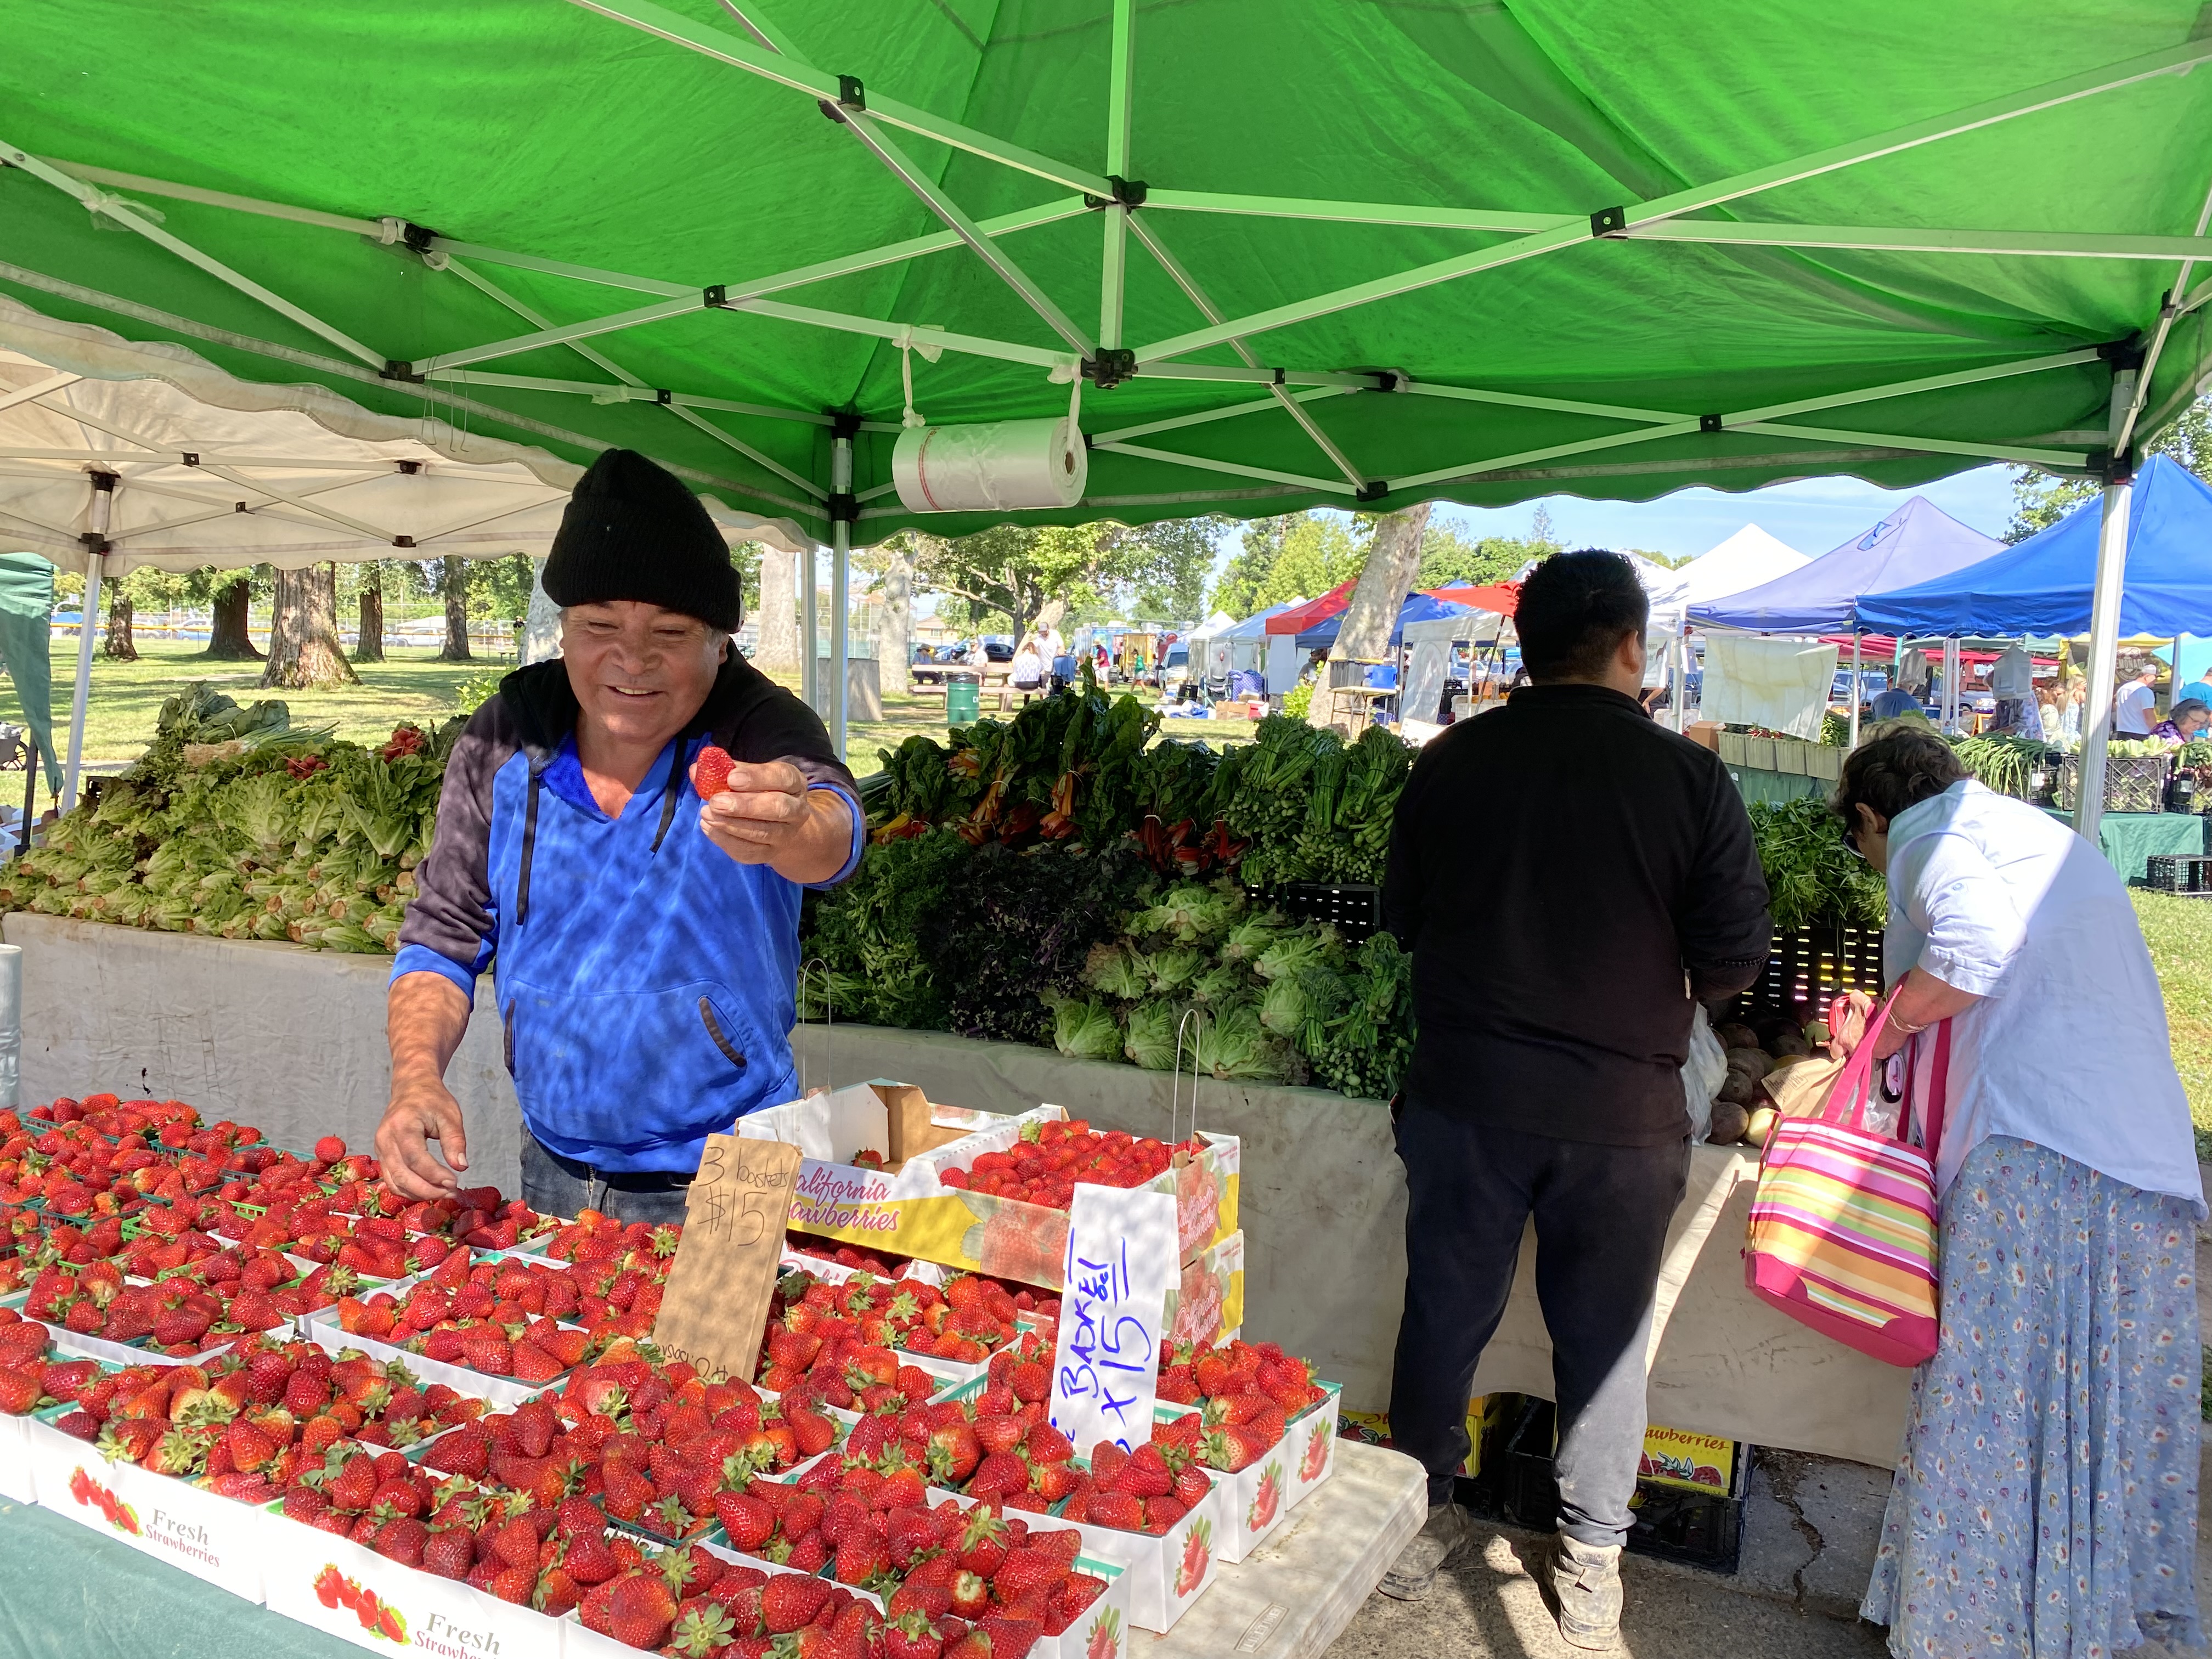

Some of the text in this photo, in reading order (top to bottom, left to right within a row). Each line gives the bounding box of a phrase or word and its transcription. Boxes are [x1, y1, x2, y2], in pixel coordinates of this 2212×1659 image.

[2116, 658, 2146, 669] EMONADE
[698, 1146, 790, 1188] 3 baskets
[795, 1166, 891, 1207] alifornia
[697, 1186, 767, 1246] $15
[789, 1198, 900, 1231] awberries
[1646, 1429, 1729, 1449] awberries
[146, 1524, 219, 1567] Strawberries
[152, 1508, 208, 1545] Fresh
[415, 1630, 496, 1659] Strawb
[426, 1612, 500, 1655] Fresh
[1243, 1606, 1283, 1649] LIFETIME
